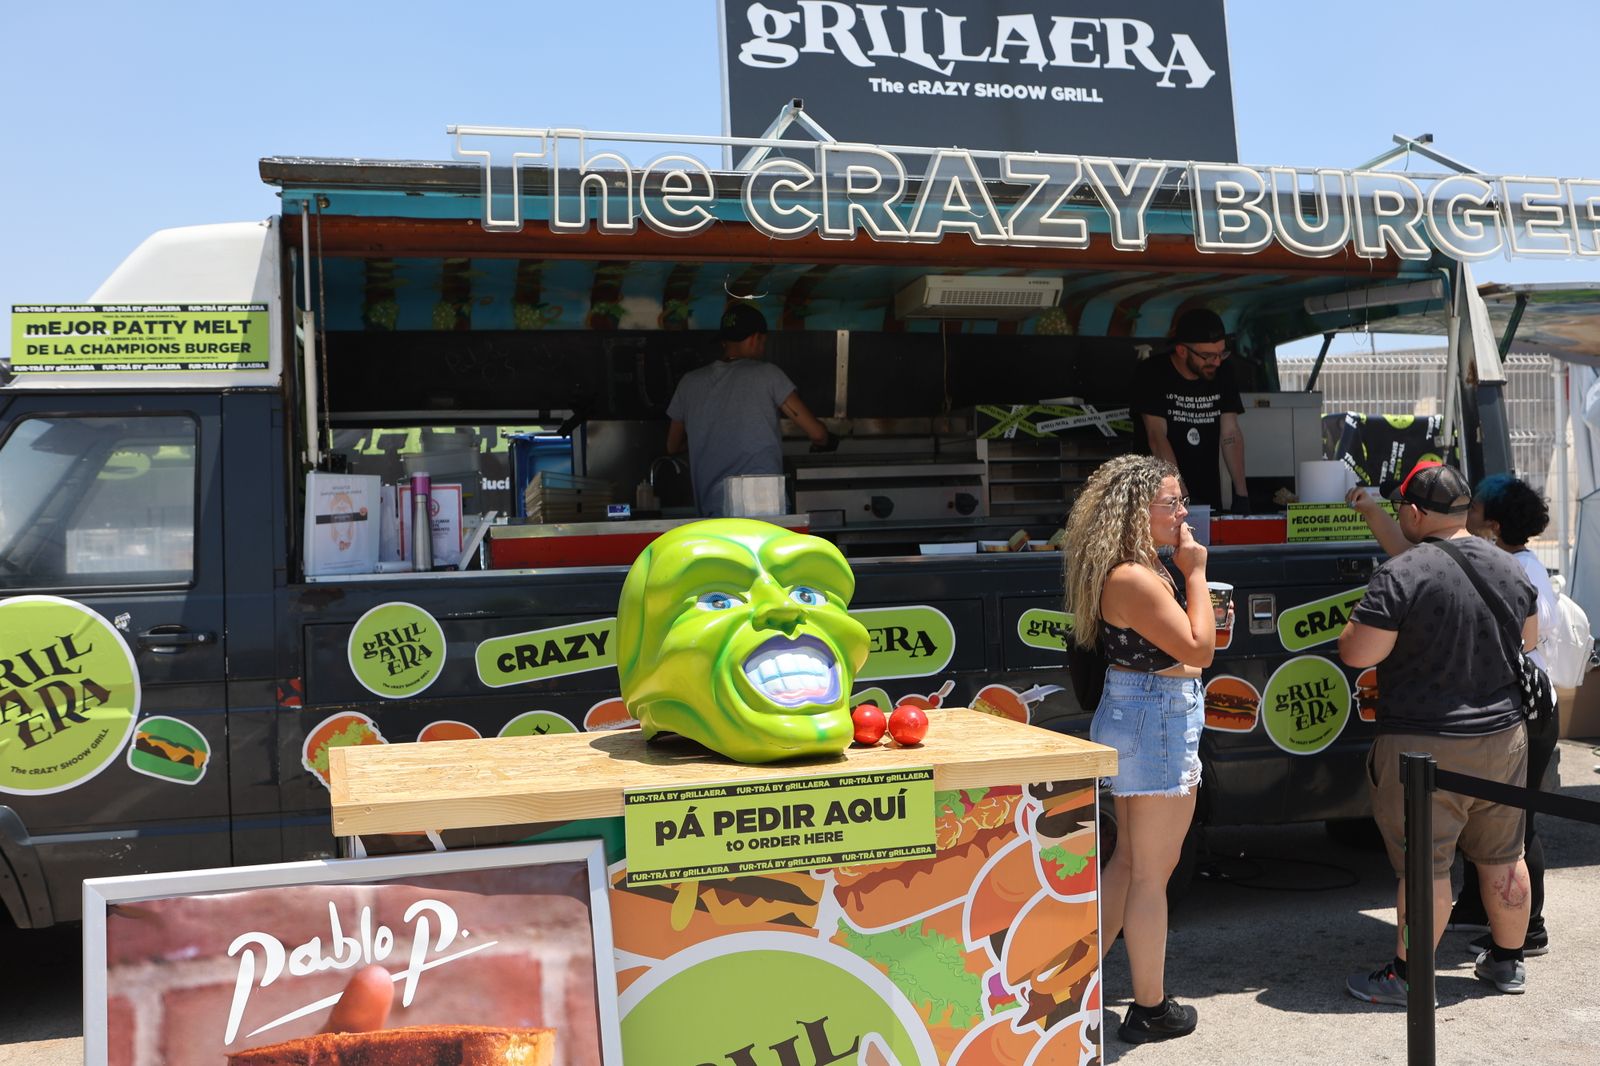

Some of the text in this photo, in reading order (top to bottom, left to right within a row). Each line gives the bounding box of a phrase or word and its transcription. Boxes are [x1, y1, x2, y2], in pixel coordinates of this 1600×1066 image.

[738, 0, 1215, 88] gRILLAERA
[868, 78, 1104, 103] The cRAZY SHOOW GRILL
[455, 126, 717, 235] The
[742, 143, 1167, 252] cRAZY
[26, 320, 252, 336] mEJOR PATTY MELT
[26, 342, 252, 355] DE LA CHAMPIONS BURGER
[1292, 515, 1330, 525] rECOGE
[1332, 513, 1358, 523] AQUÍ
[362, 622, 426, 660] gRILL
[497, 630, 610, 674] cRAZY
[1275, 678, 1336, 712] gRILL
[10, 728, 109, 776] The cRAZY SHOOW GRILL
[736, 780, 830, 795] fUR-TRÁ BY gRILLAERA
[839, 772, 930, 786] fUR-TRÁ BY gRILLAERA
[630, 789, 727, 803] fUR-TRÁ BY gRILLAERA
[654, 788, 908, 846] pÁ PEDIR AQUÍ
[726, 831, 844, 852] tO ORDER HERE
[739, 856, 833, 872] fUR-TRÁ BY gRILLAERA
[842, 847, 932, 862] fUR-TRÁ BY gRILLAERA
[632, 866, 730, 882] fUR-TRÁ BY gRILLAERA
[224, 899, 471, 1046] Pablo P.
